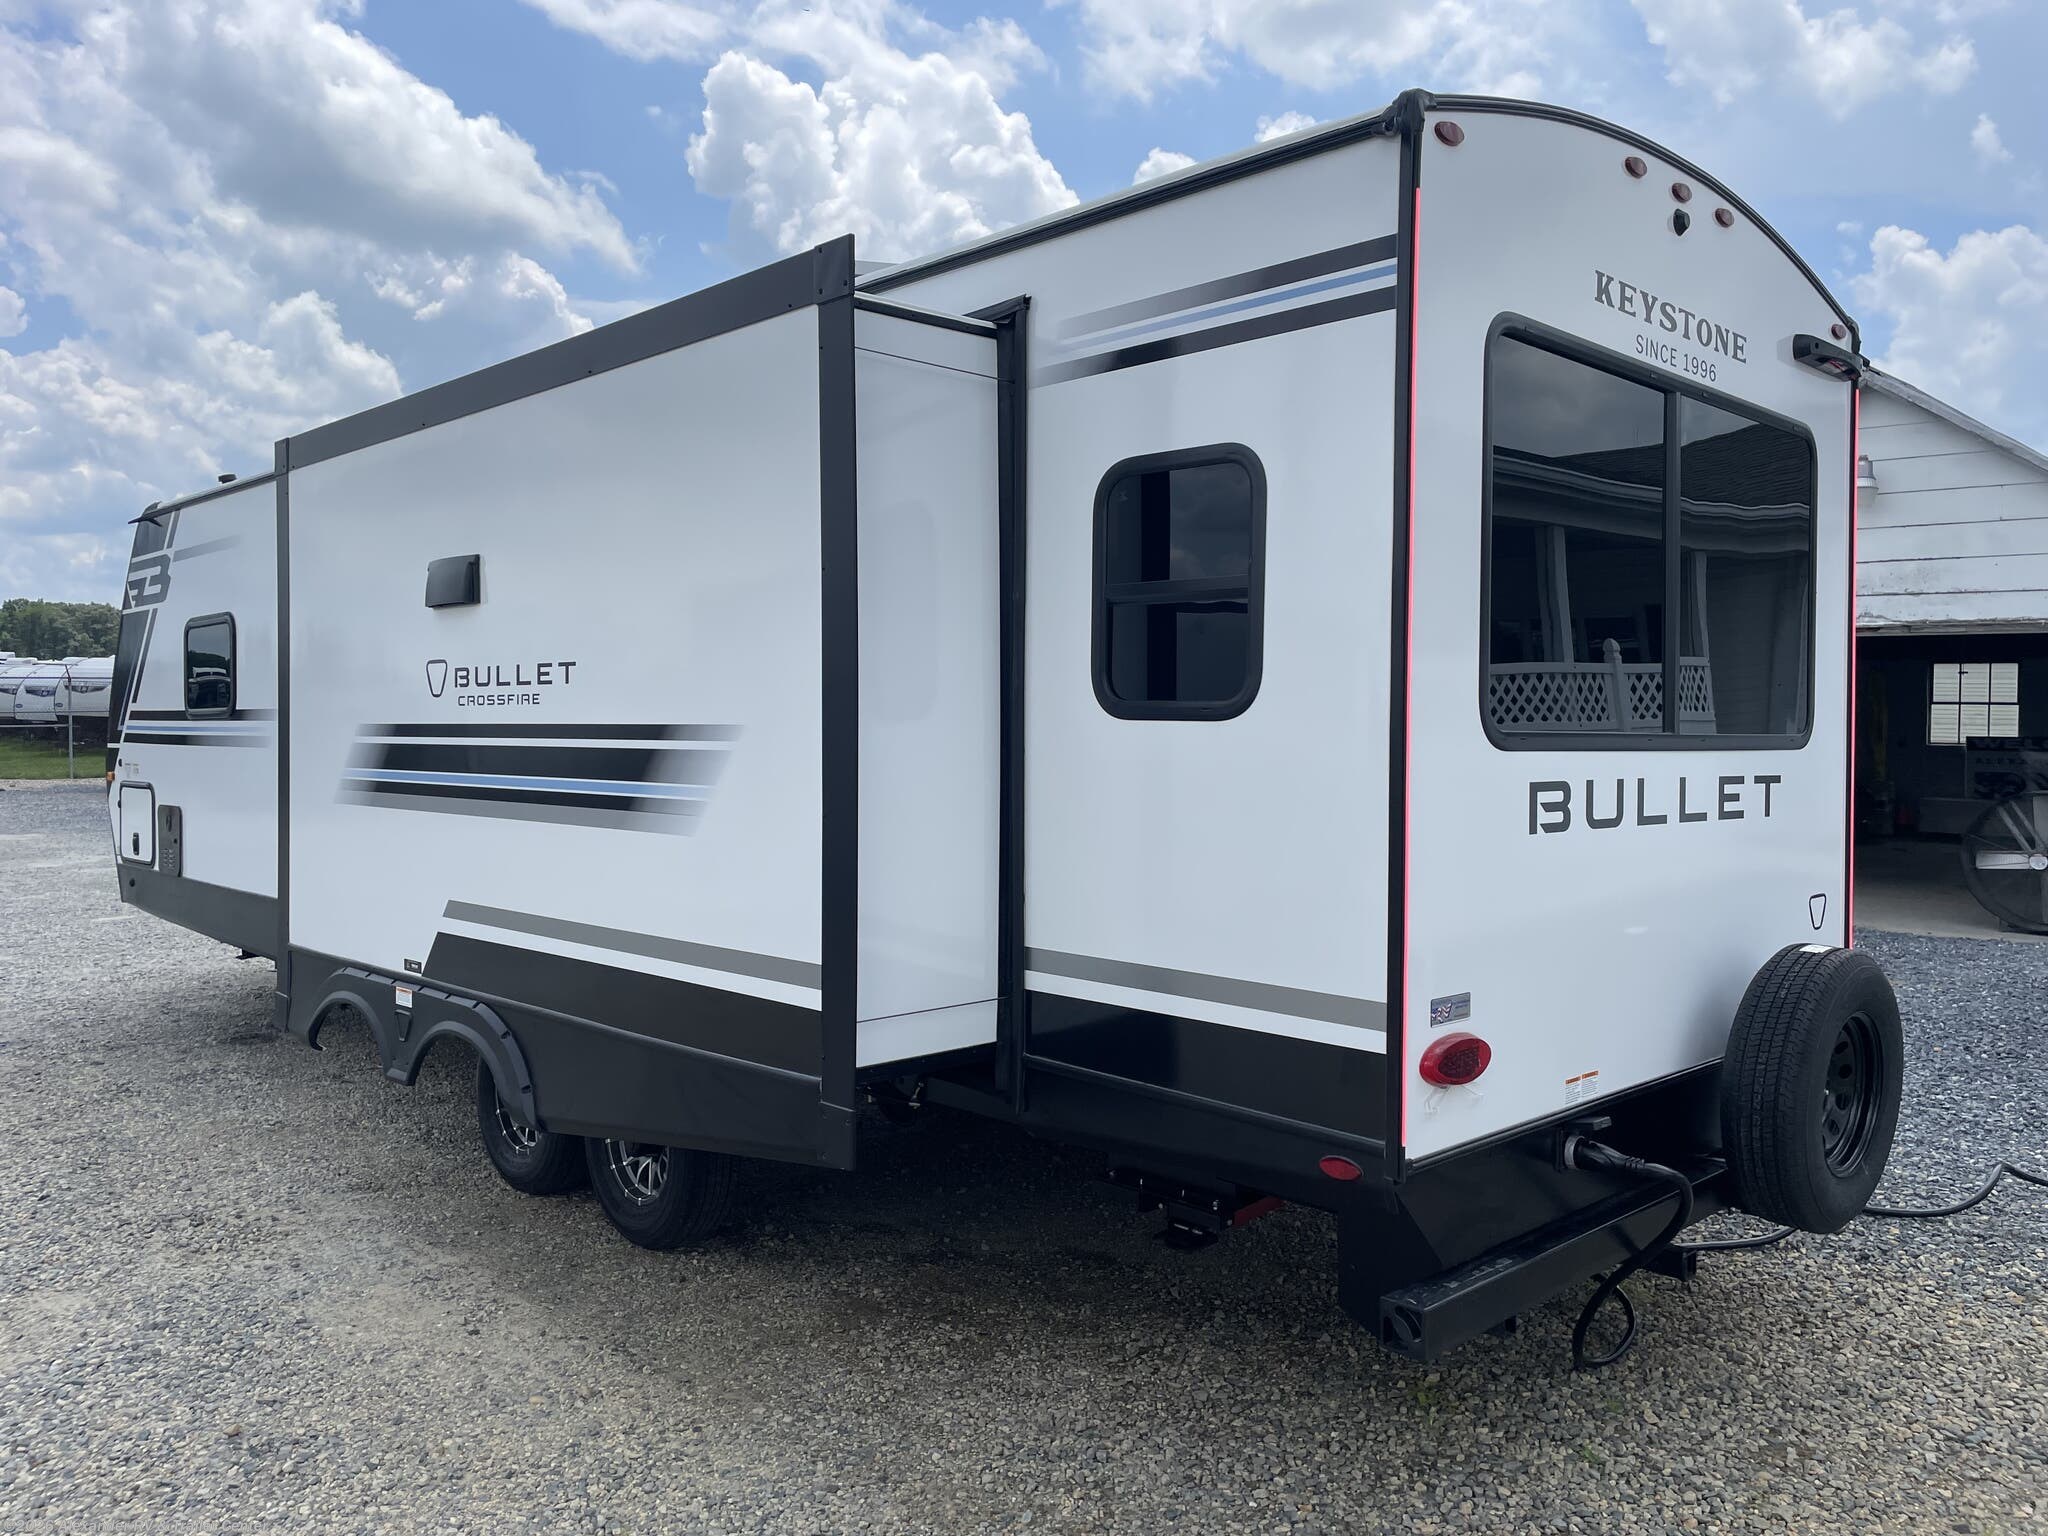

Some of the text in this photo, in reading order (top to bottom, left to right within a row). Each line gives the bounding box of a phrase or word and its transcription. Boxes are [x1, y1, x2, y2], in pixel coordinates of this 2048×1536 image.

[1594, 269, 1747, 364] KEYSTONE
[1635, 334, 1717, 382] SINCE 1996
[454, 661, 577, 688] BULLET
[457, 693, 541, 706] CROSSFIRE
[1529, 774, 1782, 835] BULLET
